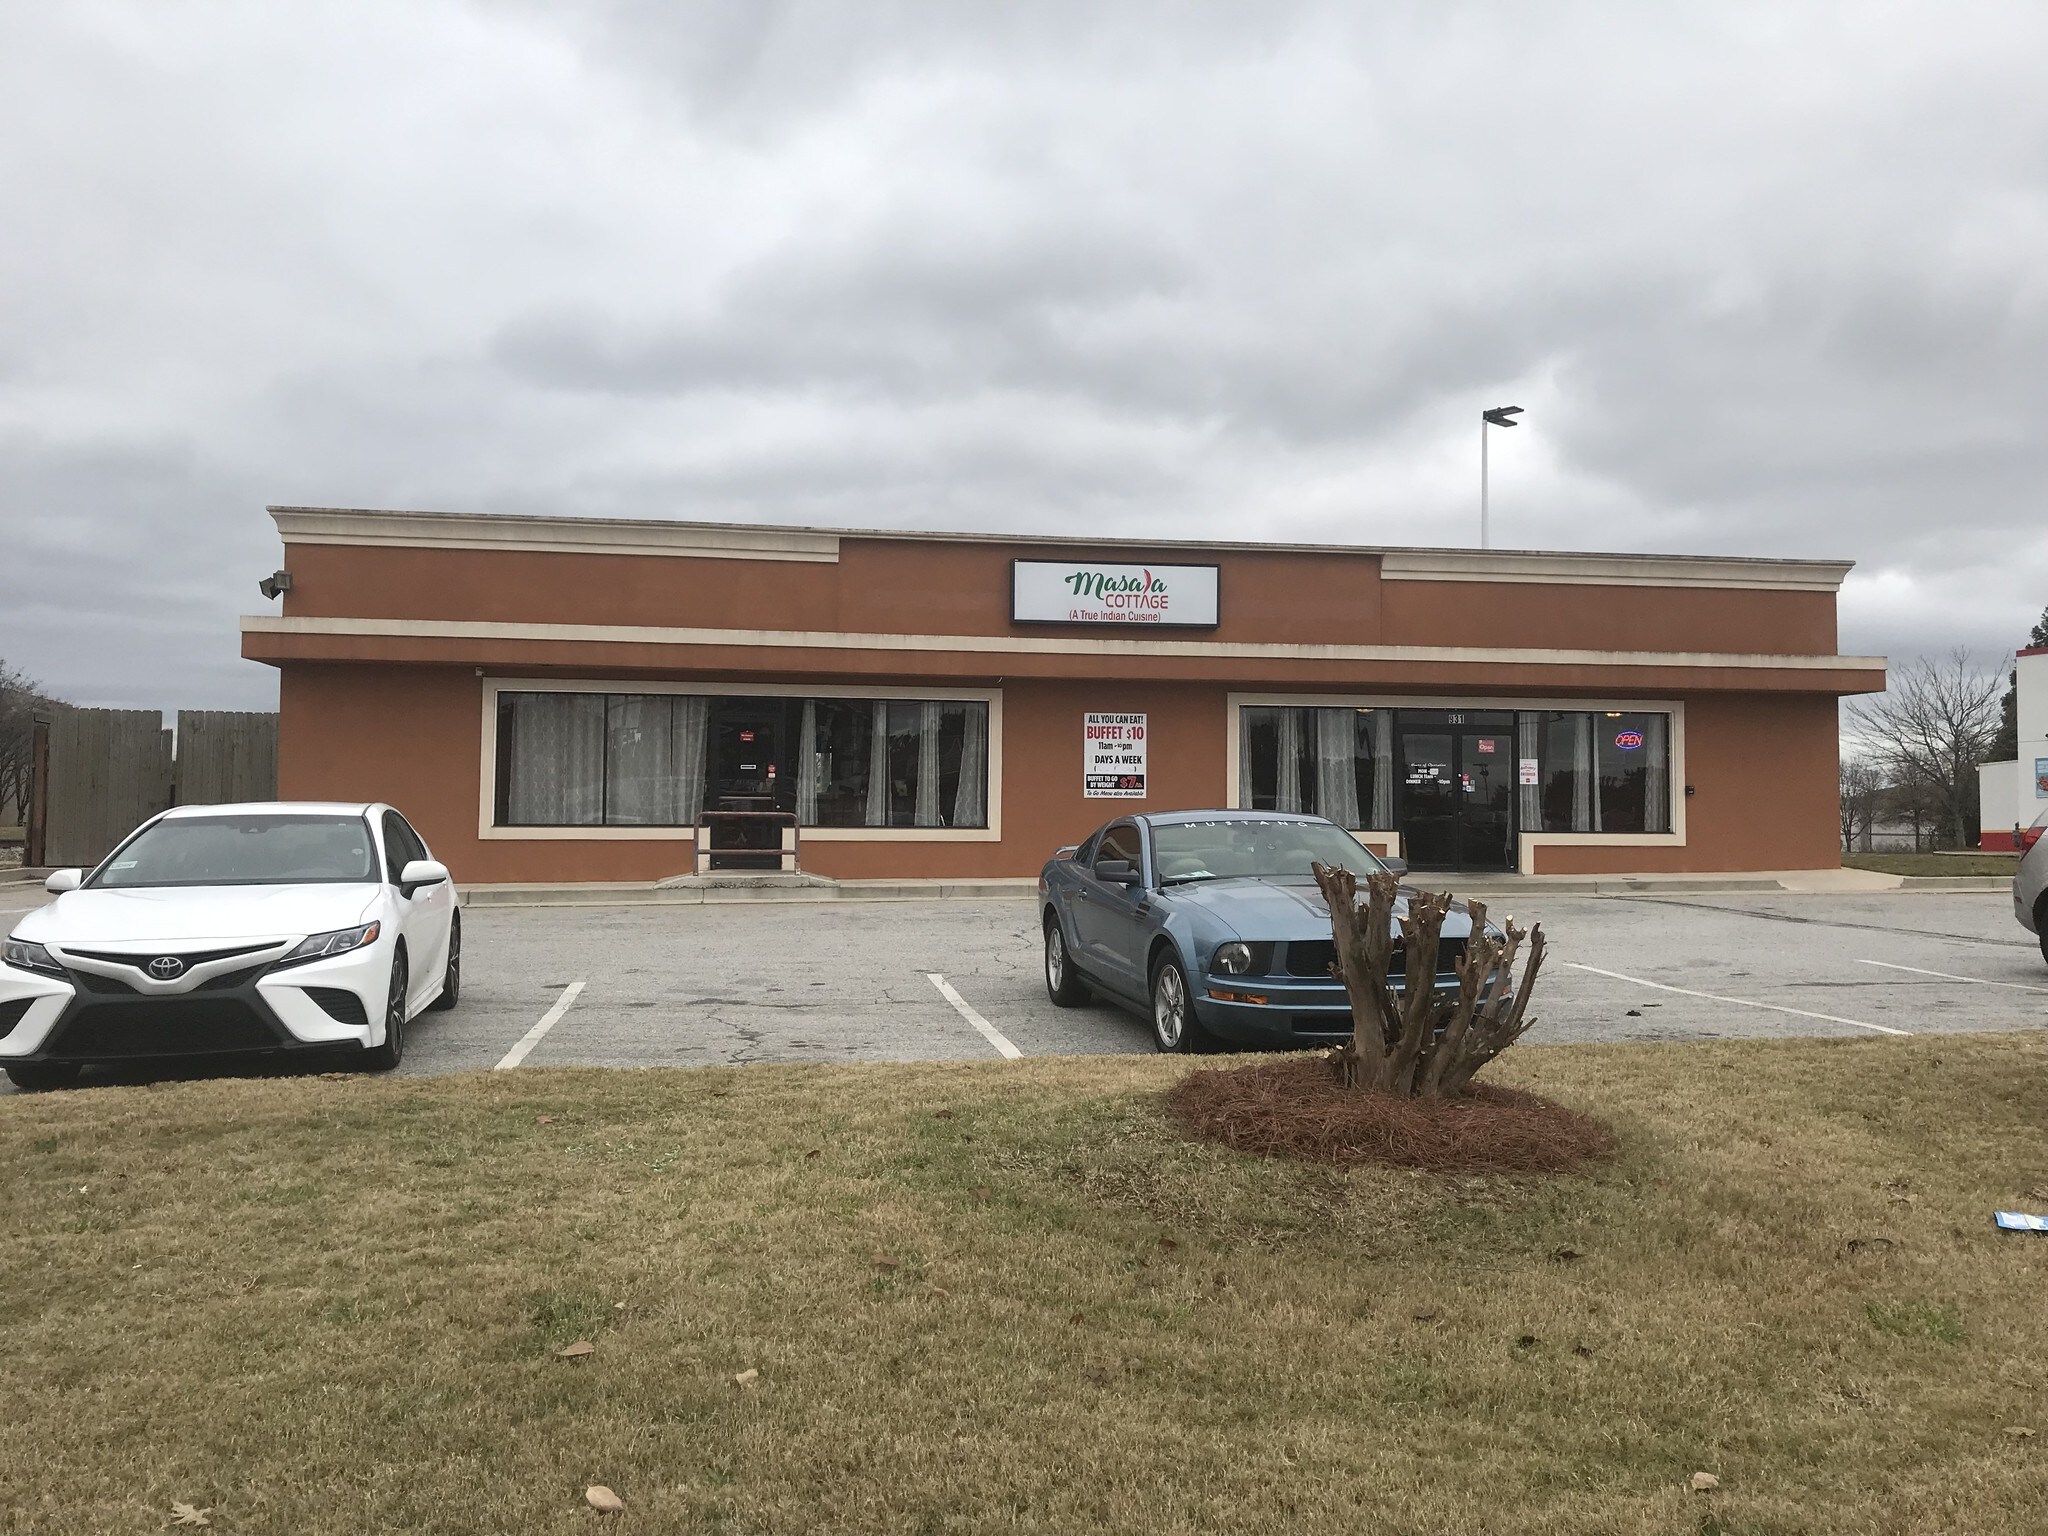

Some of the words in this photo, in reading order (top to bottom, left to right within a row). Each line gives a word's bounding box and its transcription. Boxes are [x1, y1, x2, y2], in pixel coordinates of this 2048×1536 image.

[1065, 568, 1167, 600] Masala
[1105, 594, 1168, 609] COTTAGE
[1069, 609, 1078, 621] (A
[1080, 610, 1098, 621] True
[1100, 610, 1126, 621] Indian
[1128, 611, 1161, 623] Cuisine)
[1088, 715, 1099, 724] ALL
[1101, 715, 1114, 724] YOU
[1115, 715, 1128, 724] CAN
[1129, 715, 1143, 724] EAT!
[1087, 726, 1123, 739] BUFFET
[1126, 726, 1144, 740] $10
[1615, 734, 1643, 746] OPEN
[1095, 755, 1113, 764] DAYS
[1115, 755, 1120, 764] A
[1122, 755, 1142, 764] WEEK
[1184, 820, 1307, 828] MUSTANG
